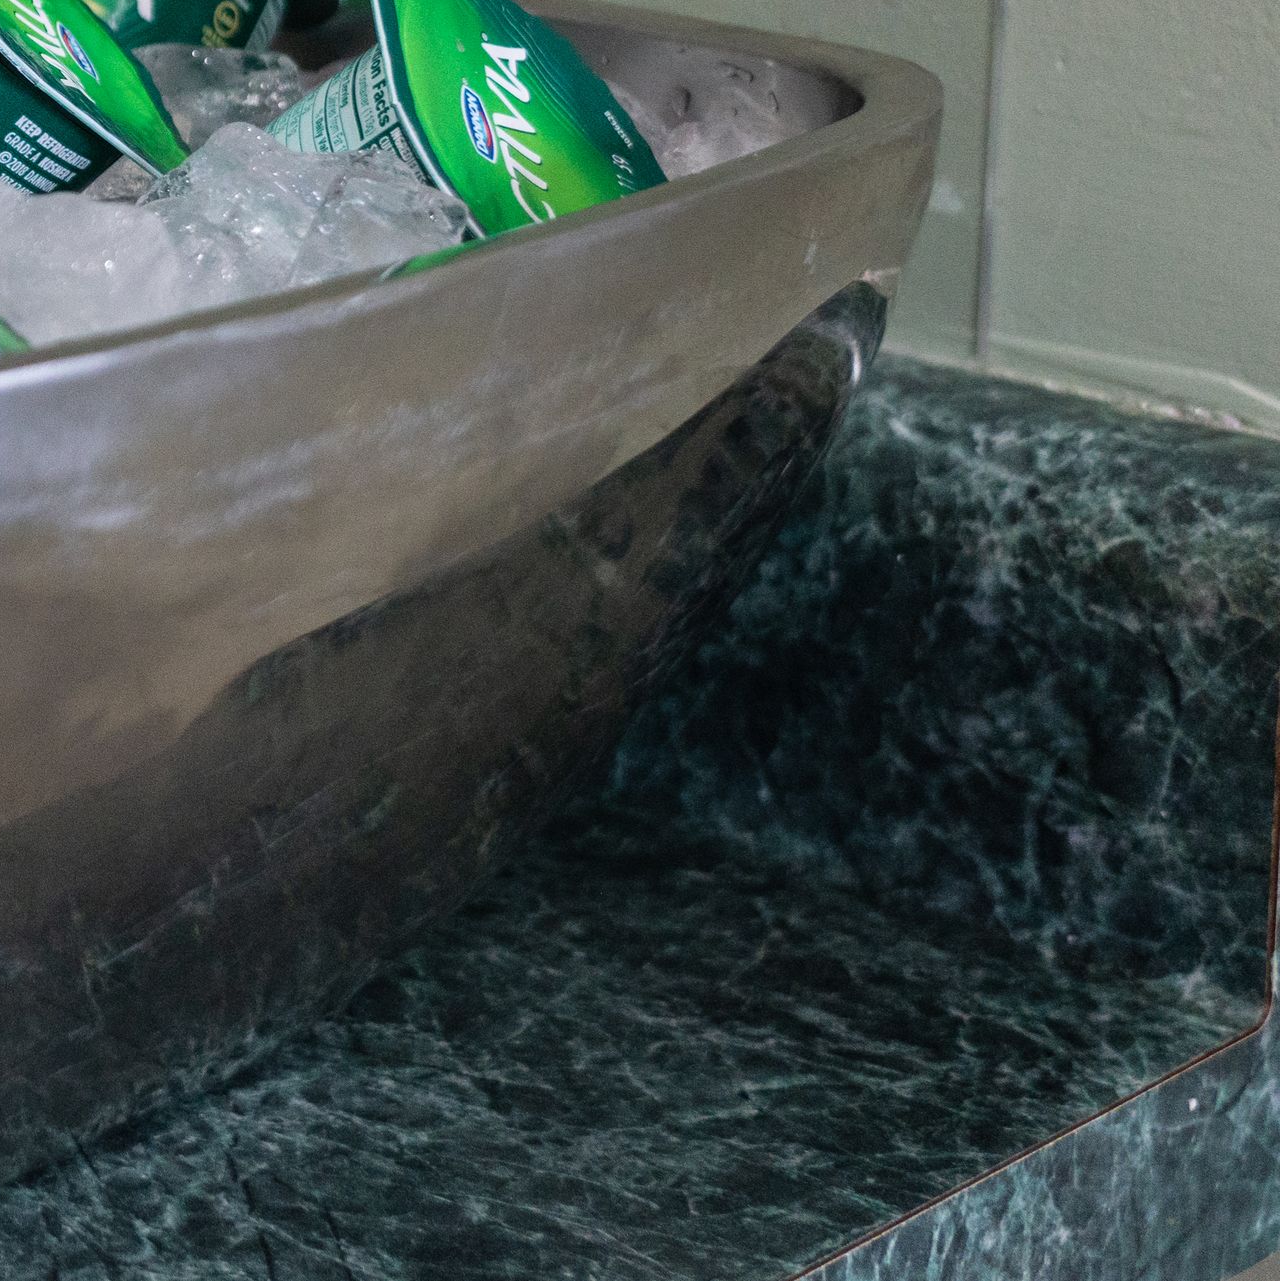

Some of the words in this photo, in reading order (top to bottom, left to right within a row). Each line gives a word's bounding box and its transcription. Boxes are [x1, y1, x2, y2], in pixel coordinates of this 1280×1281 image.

[373, 77, 391, 127] Facts
[464, 91, 490, 156] DANNON
[3, 131, 37, 160] GRADE
[30, 152, 42, 163] A
[38, 156, 72, 181] KOSHER
[14, 114, 43, 139] KEEP
[36, 132, 92, 170] REFRIGERATED
[23, 170, 58, 193] DANNON
